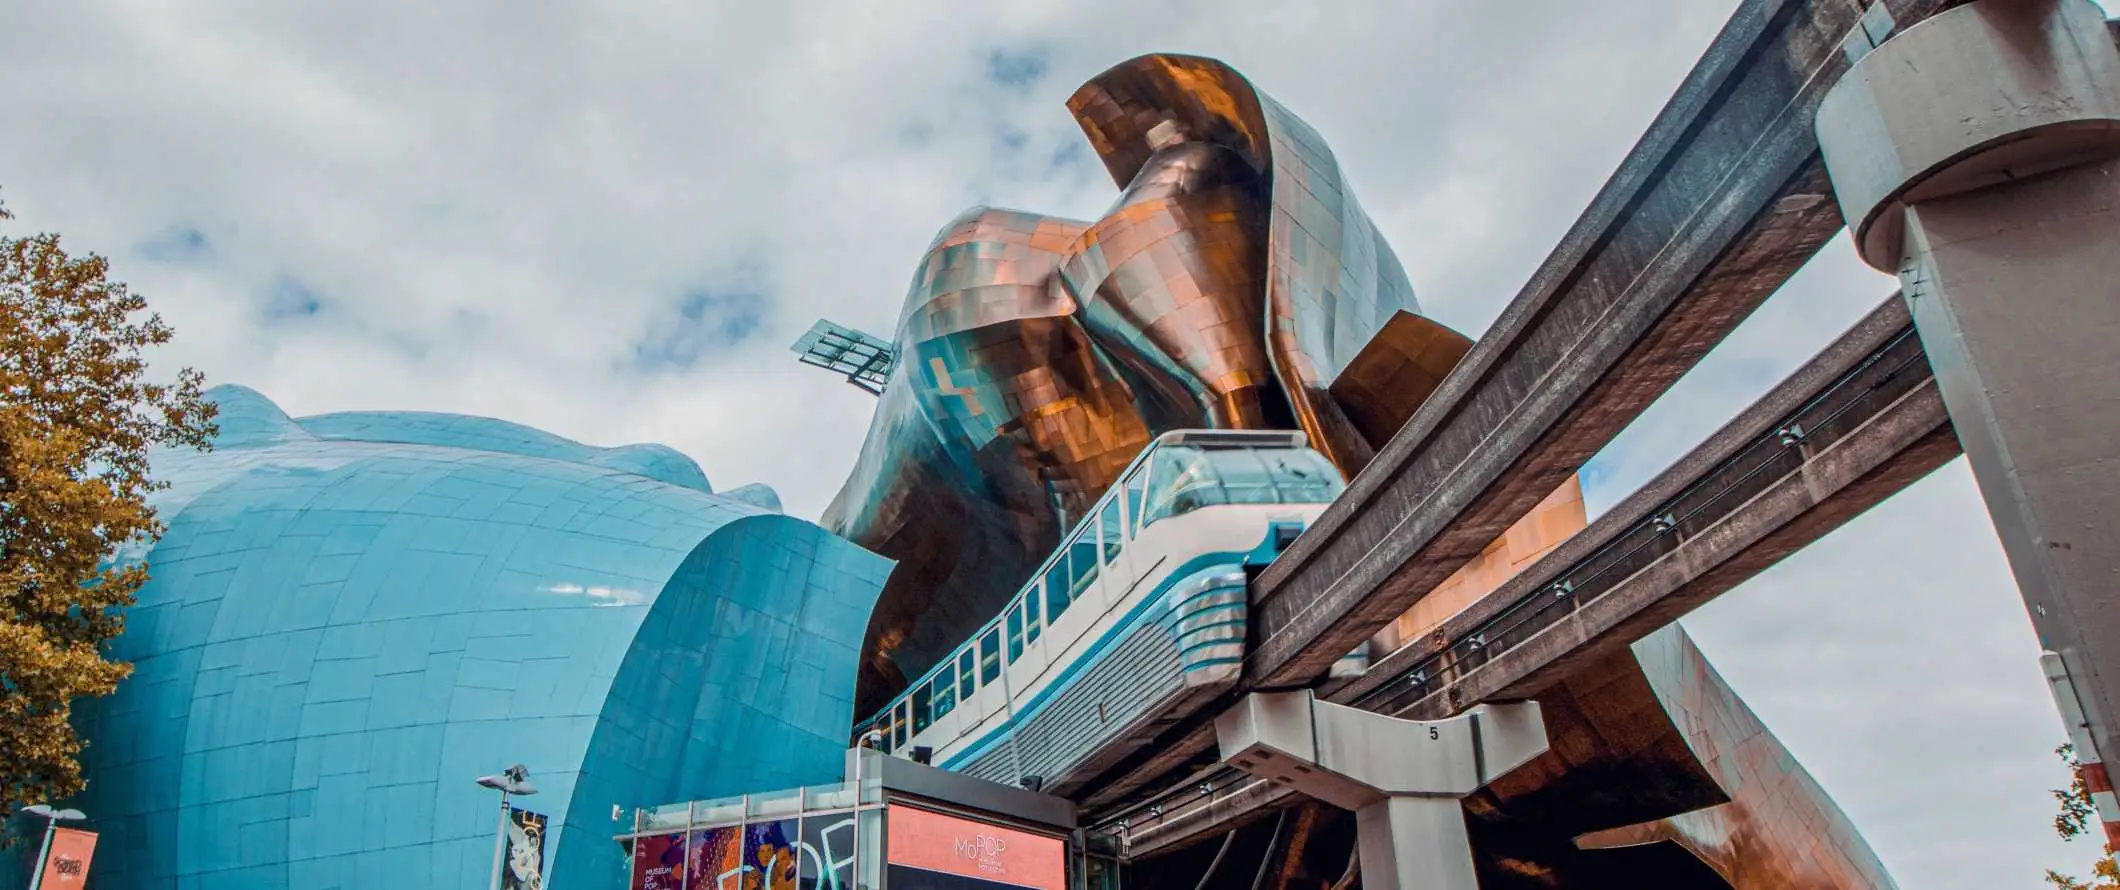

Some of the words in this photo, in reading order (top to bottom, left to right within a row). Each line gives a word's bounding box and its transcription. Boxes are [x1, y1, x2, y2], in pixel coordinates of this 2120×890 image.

[1430, 727, 1439, 740] 5
[955, 834, 1006, 859] MoPOP
[645, 866, 672, 876] MUSEUM
[644, 875, 655, 883] OF
[644, 881, 658, 889] POP
